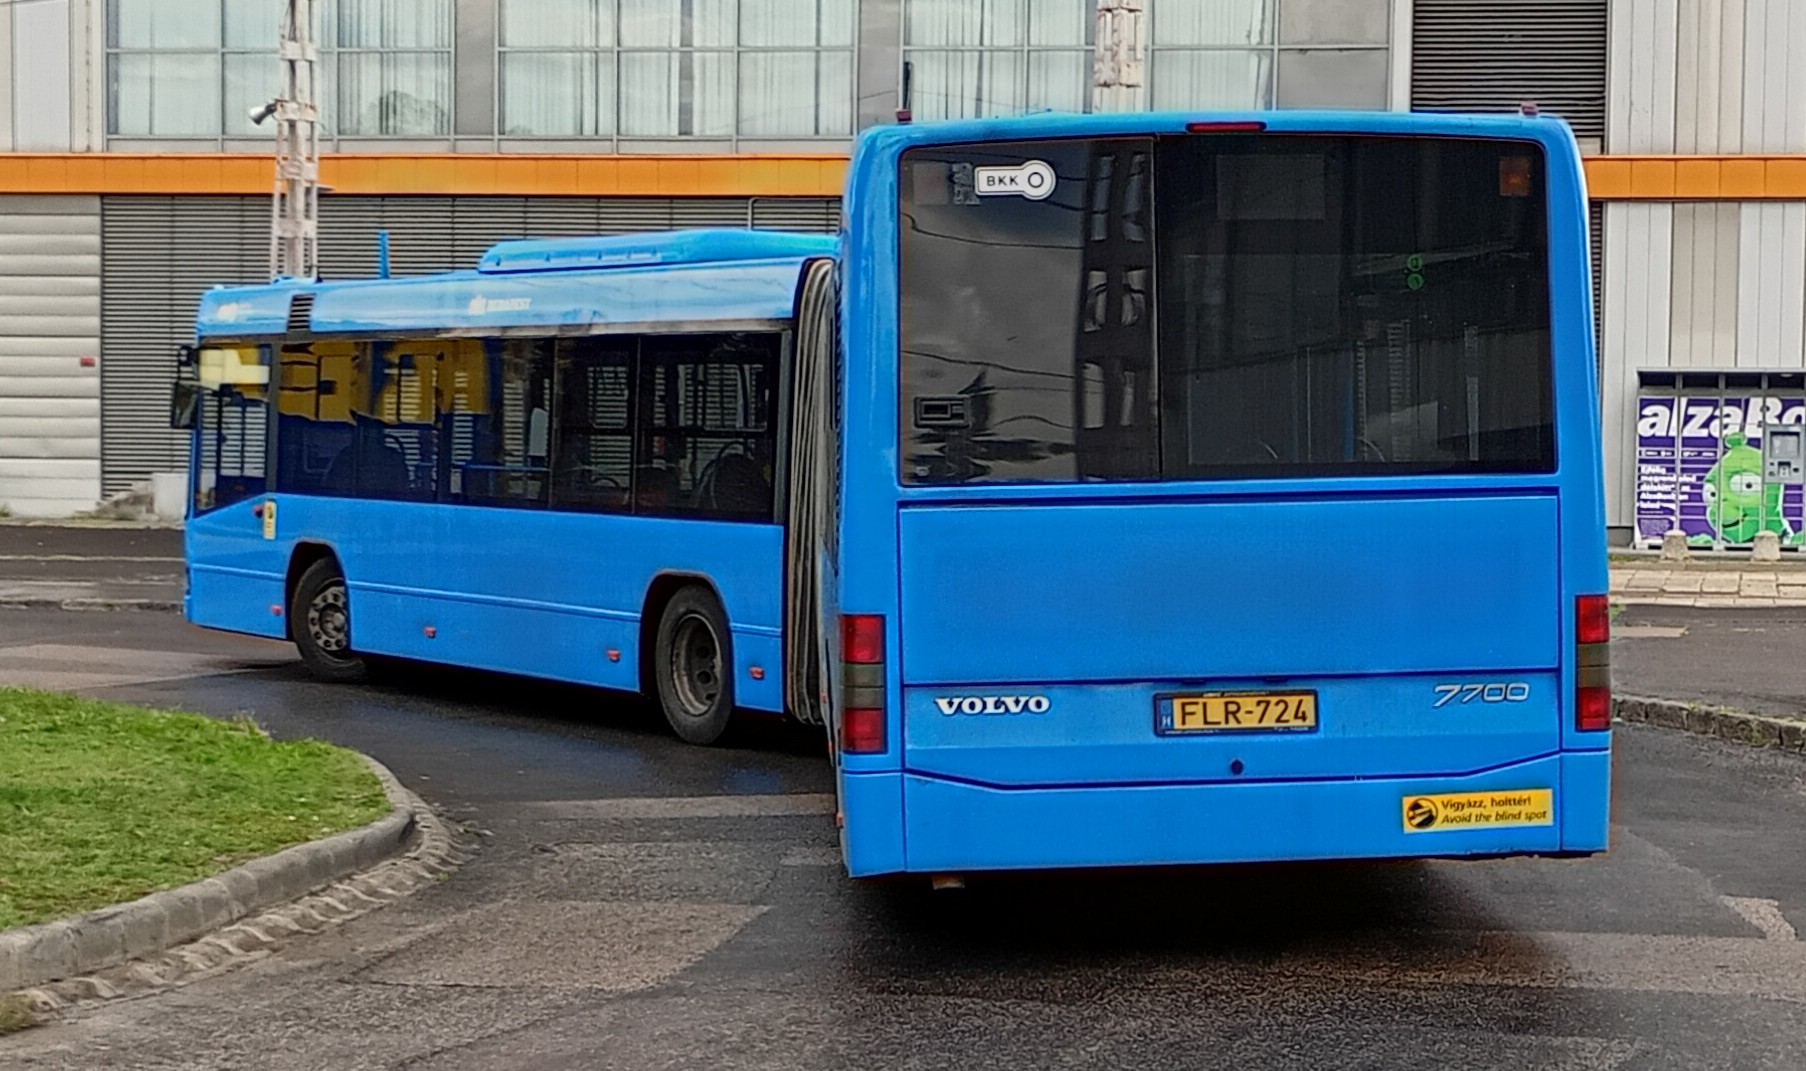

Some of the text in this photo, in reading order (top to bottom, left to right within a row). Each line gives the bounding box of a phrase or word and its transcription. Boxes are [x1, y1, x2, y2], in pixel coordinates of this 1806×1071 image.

[986, 175, 1019, 187] BKK
[1432, 683, 1530, 707] 7700
[935, 696, 1050, 715] VOLVO
[1180, 698, 1308, 726] FLR-724
[1441, 810, 1548, 824] Avoid the blind spot
